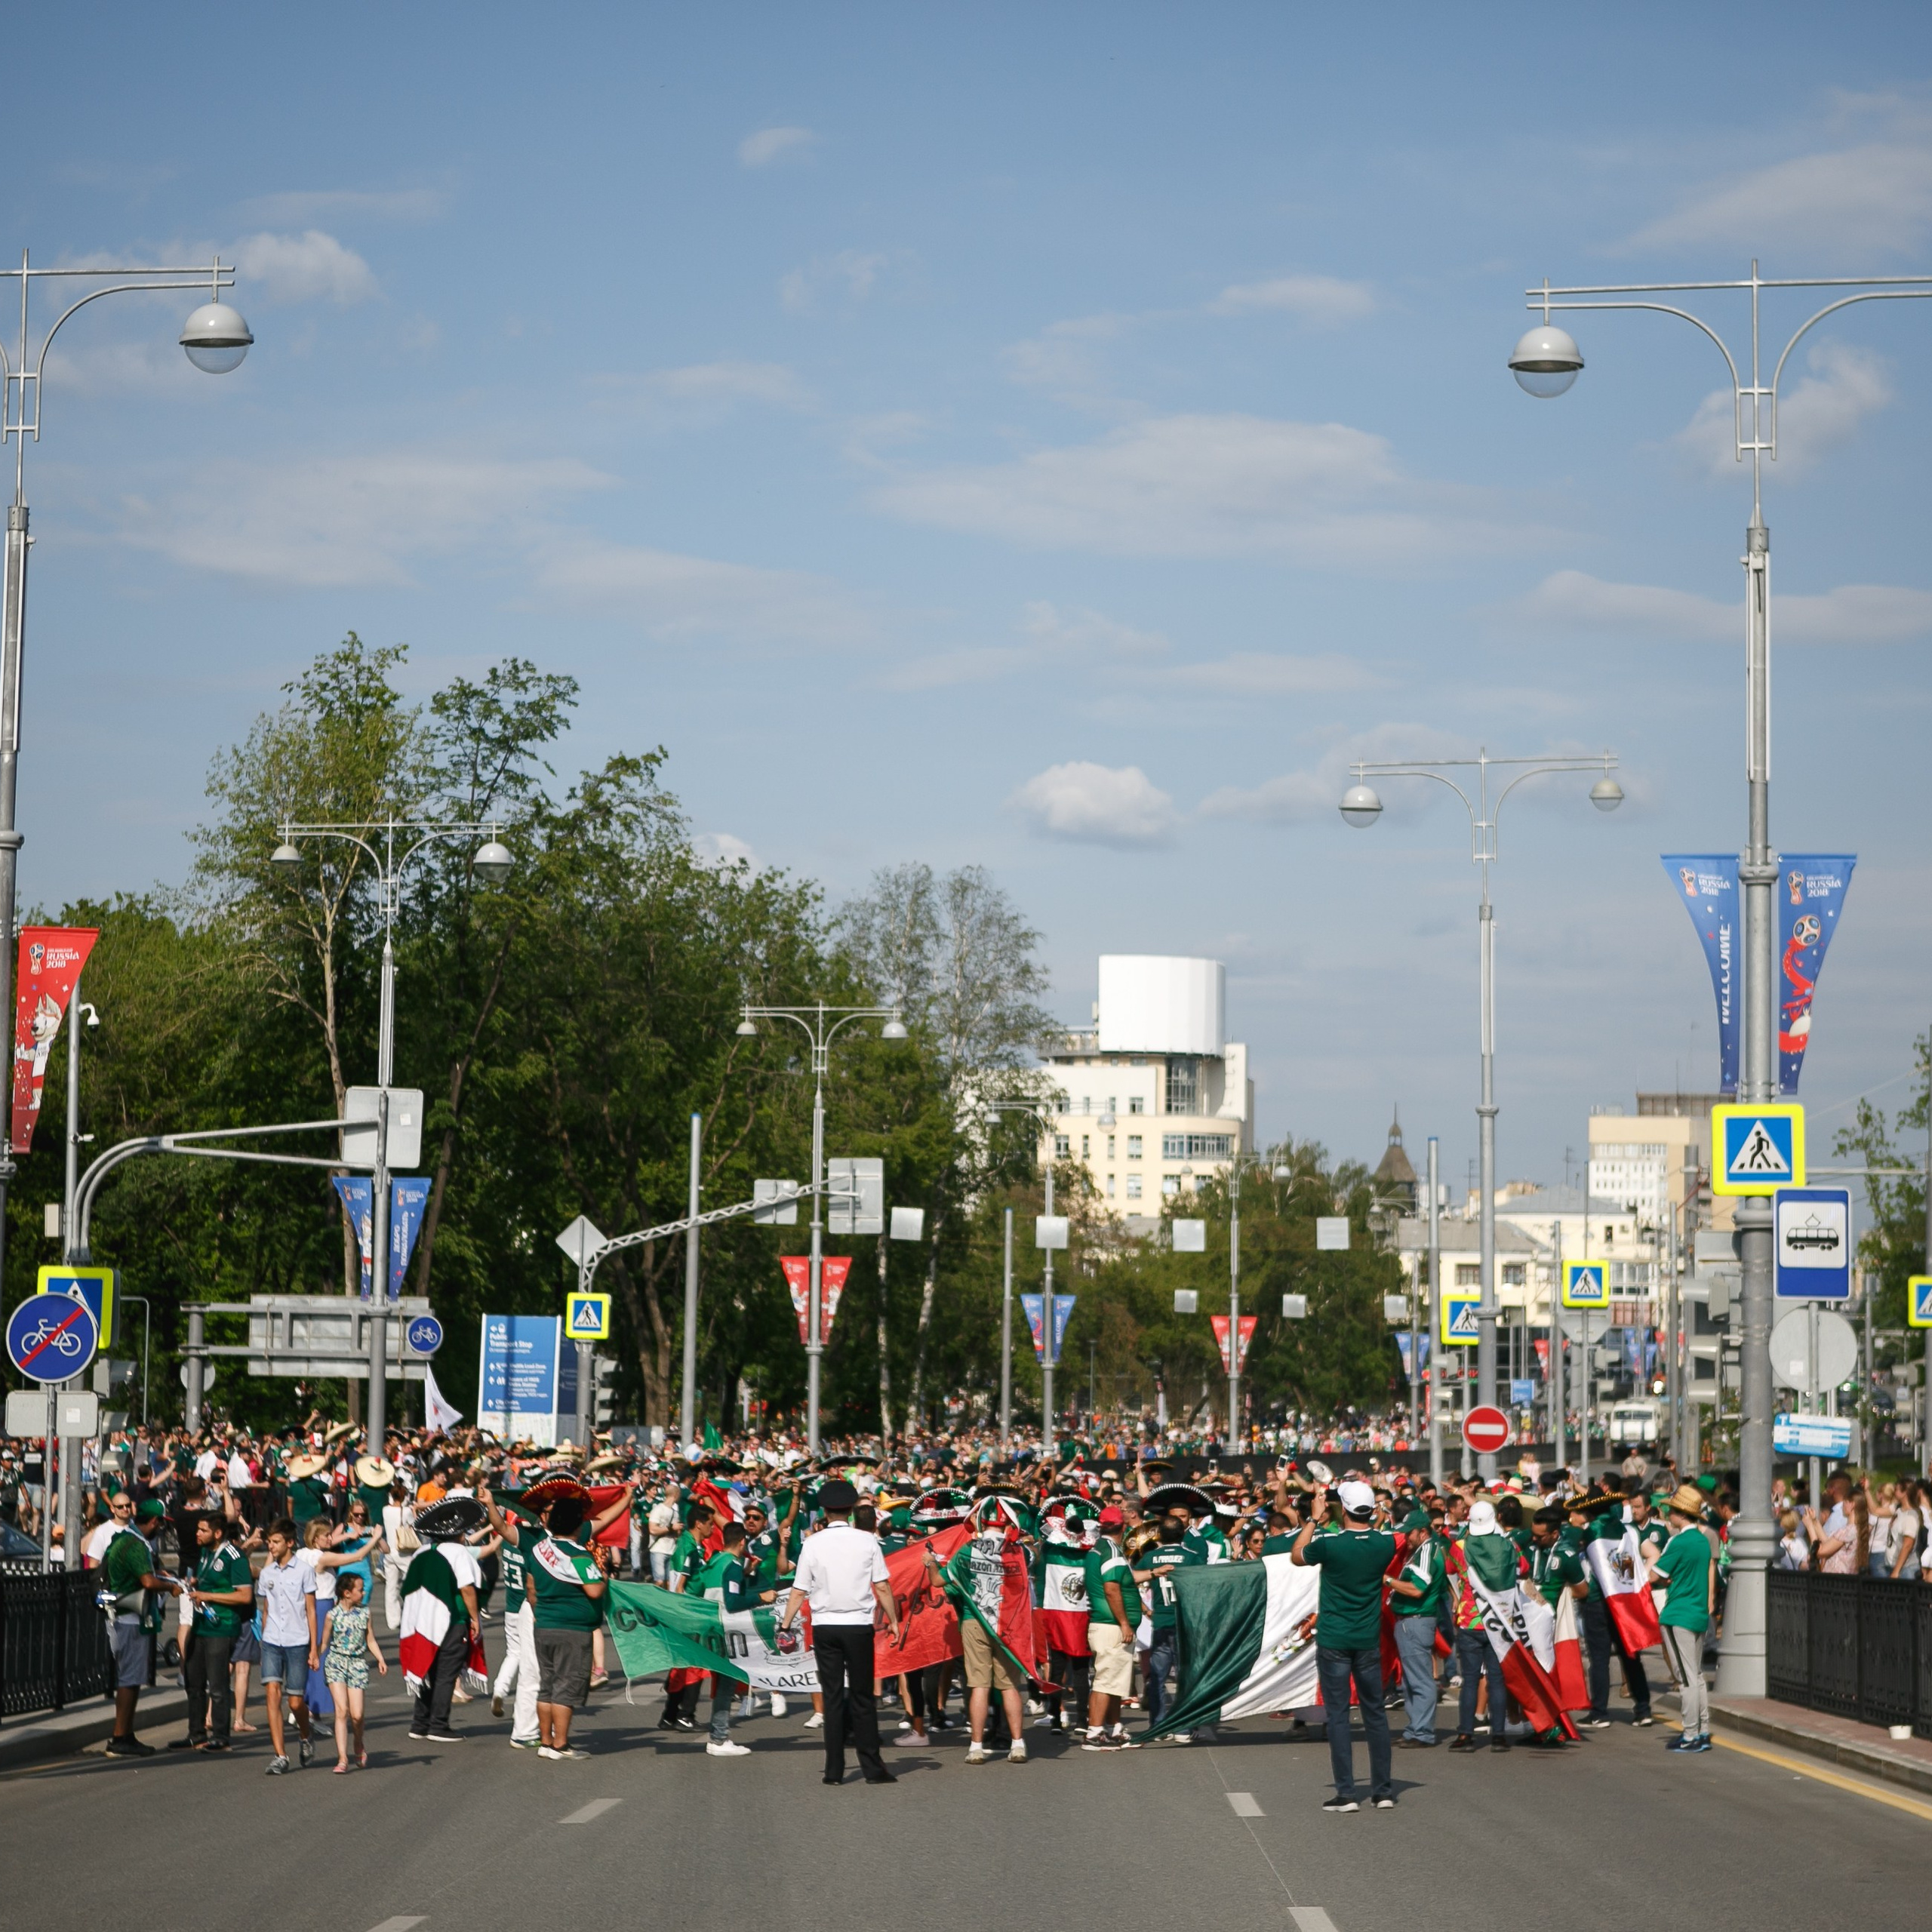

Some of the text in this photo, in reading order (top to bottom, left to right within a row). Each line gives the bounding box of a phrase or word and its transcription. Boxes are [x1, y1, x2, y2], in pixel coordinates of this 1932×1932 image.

[1698, 878, 1730, 889] RUSSIA
[1806, 879, 1841, 889] RUSSIA
[1701, 887, 1719, 896] 2018
[1807, 888, 1829, 897] 2018
[46, 952, 79, 961] RUSSIA
[46, 960, 66, 968] 2018
[1719, 923, 1730, 1025] WELCOME
[518, 1340, 533, 1349] Stop
[502, 1560, 525, 1590] 23
